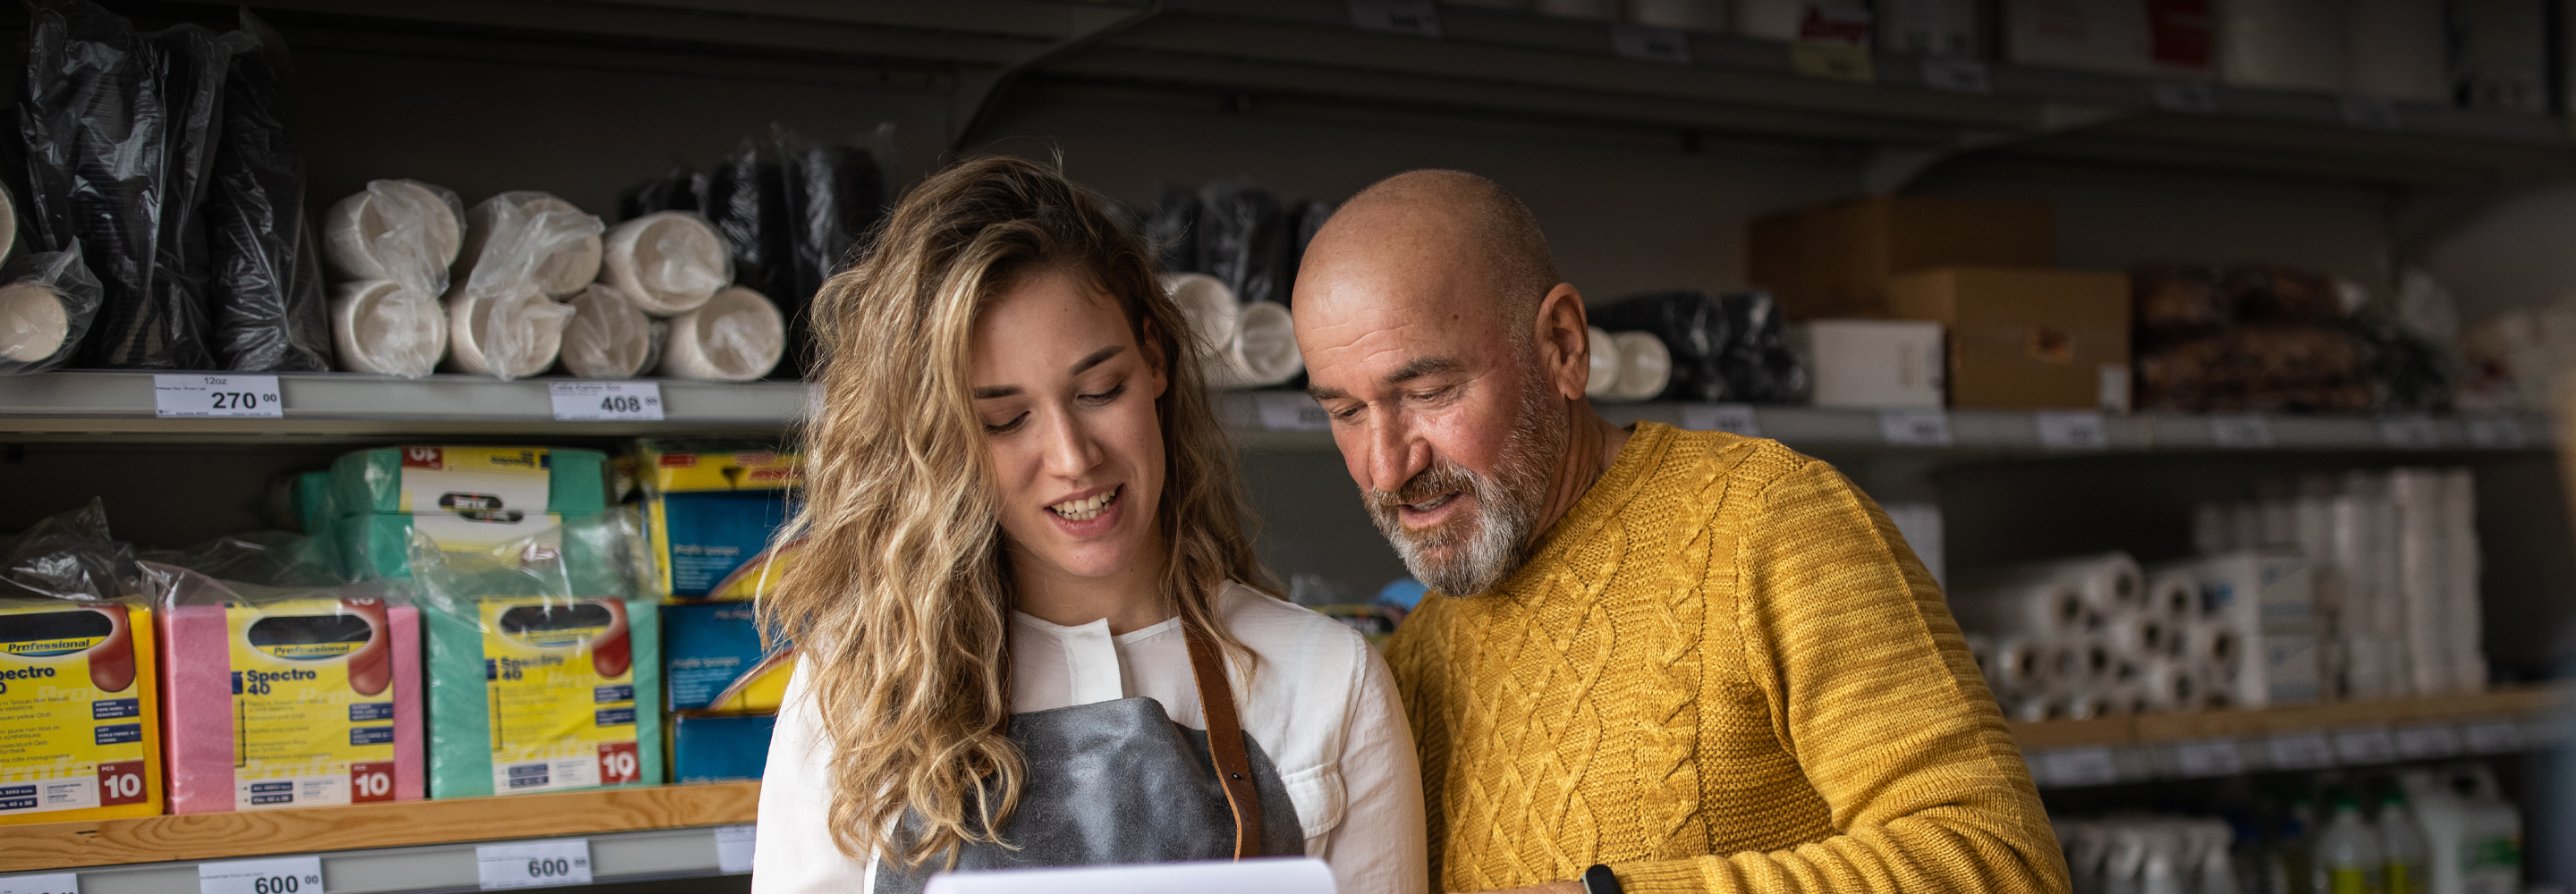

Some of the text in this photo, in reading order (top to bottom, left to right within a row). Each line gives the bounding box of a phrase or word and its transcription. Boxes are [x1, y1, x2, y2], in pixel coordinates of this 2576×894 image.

[204, 377, 227, 385] 12oz
[211, 392, 277, 409] 270 00
[601, 396, 641, 412] 408
[8, 638, 90, 653] Professional
[247, 669, 317, 685] Spectro
[247, 683, 271, 695] 40
[603, 751, 636, 778] 10
[104, 773, 141, 799] 10
[355, 772, 390, 797] 10
[528, 858, 568, 877] 600
[254, 875, 299, 894] 600
[304, 875, 318, 885] 00
